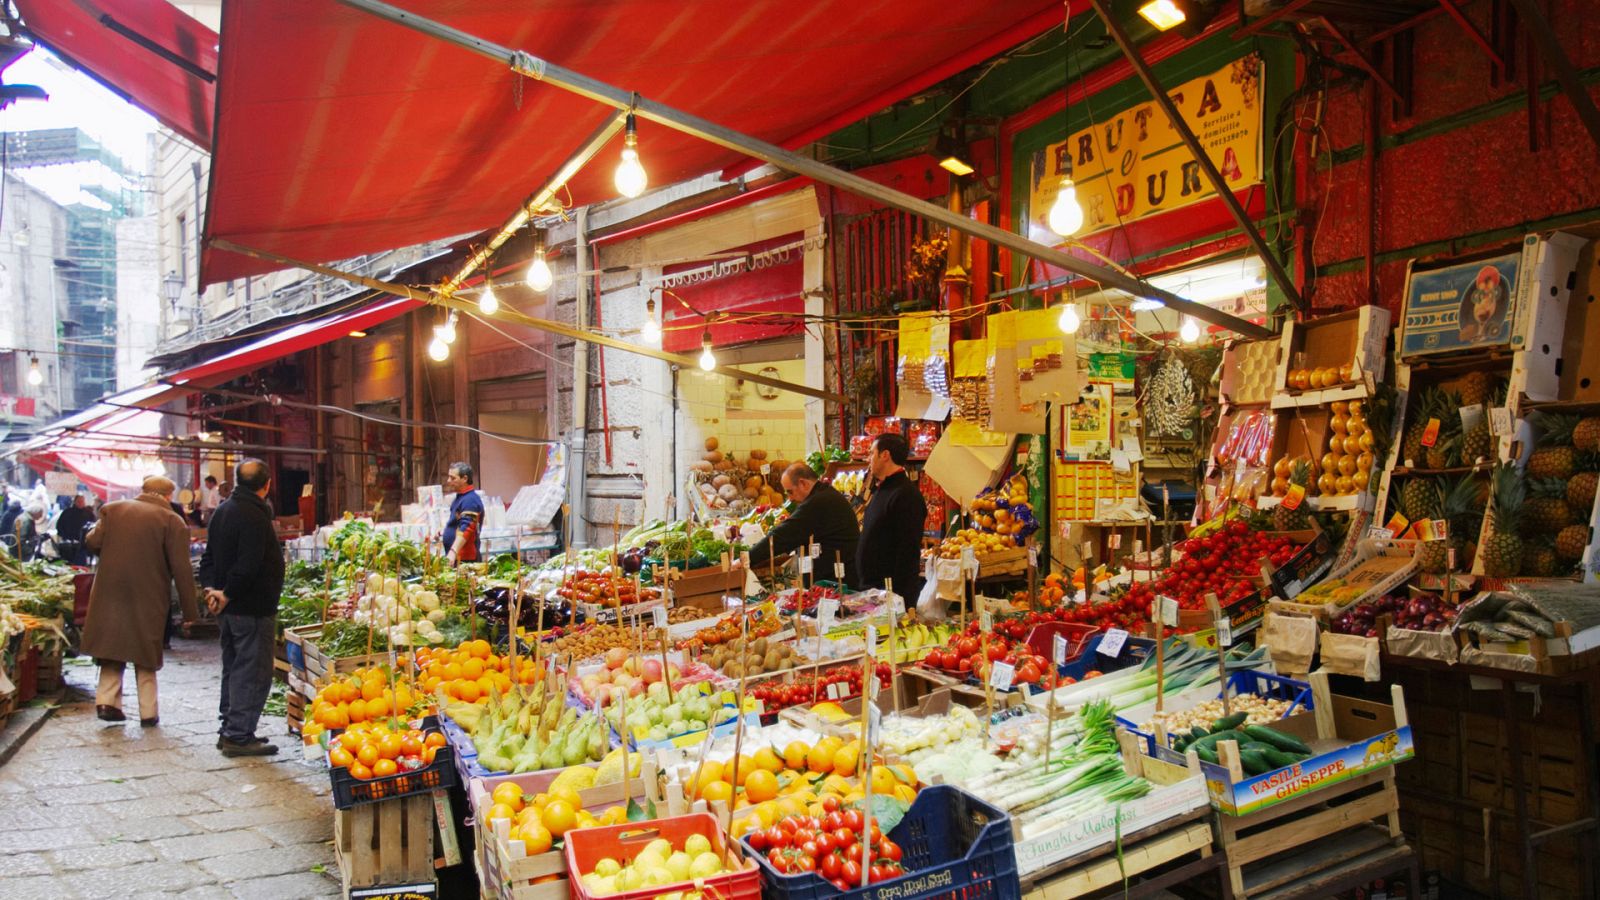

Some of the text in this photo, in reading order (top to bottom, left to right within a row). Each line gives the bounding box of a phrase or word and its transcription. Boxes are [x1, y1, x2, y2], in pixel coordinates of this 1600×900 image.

[1203, 121, 1240, 139] domicilio
[1121, 149, 1138, 177] e
[1250, 764, 1302, 795] VASILE
[1276, 759, 1346, 799] GIUSEPPE
